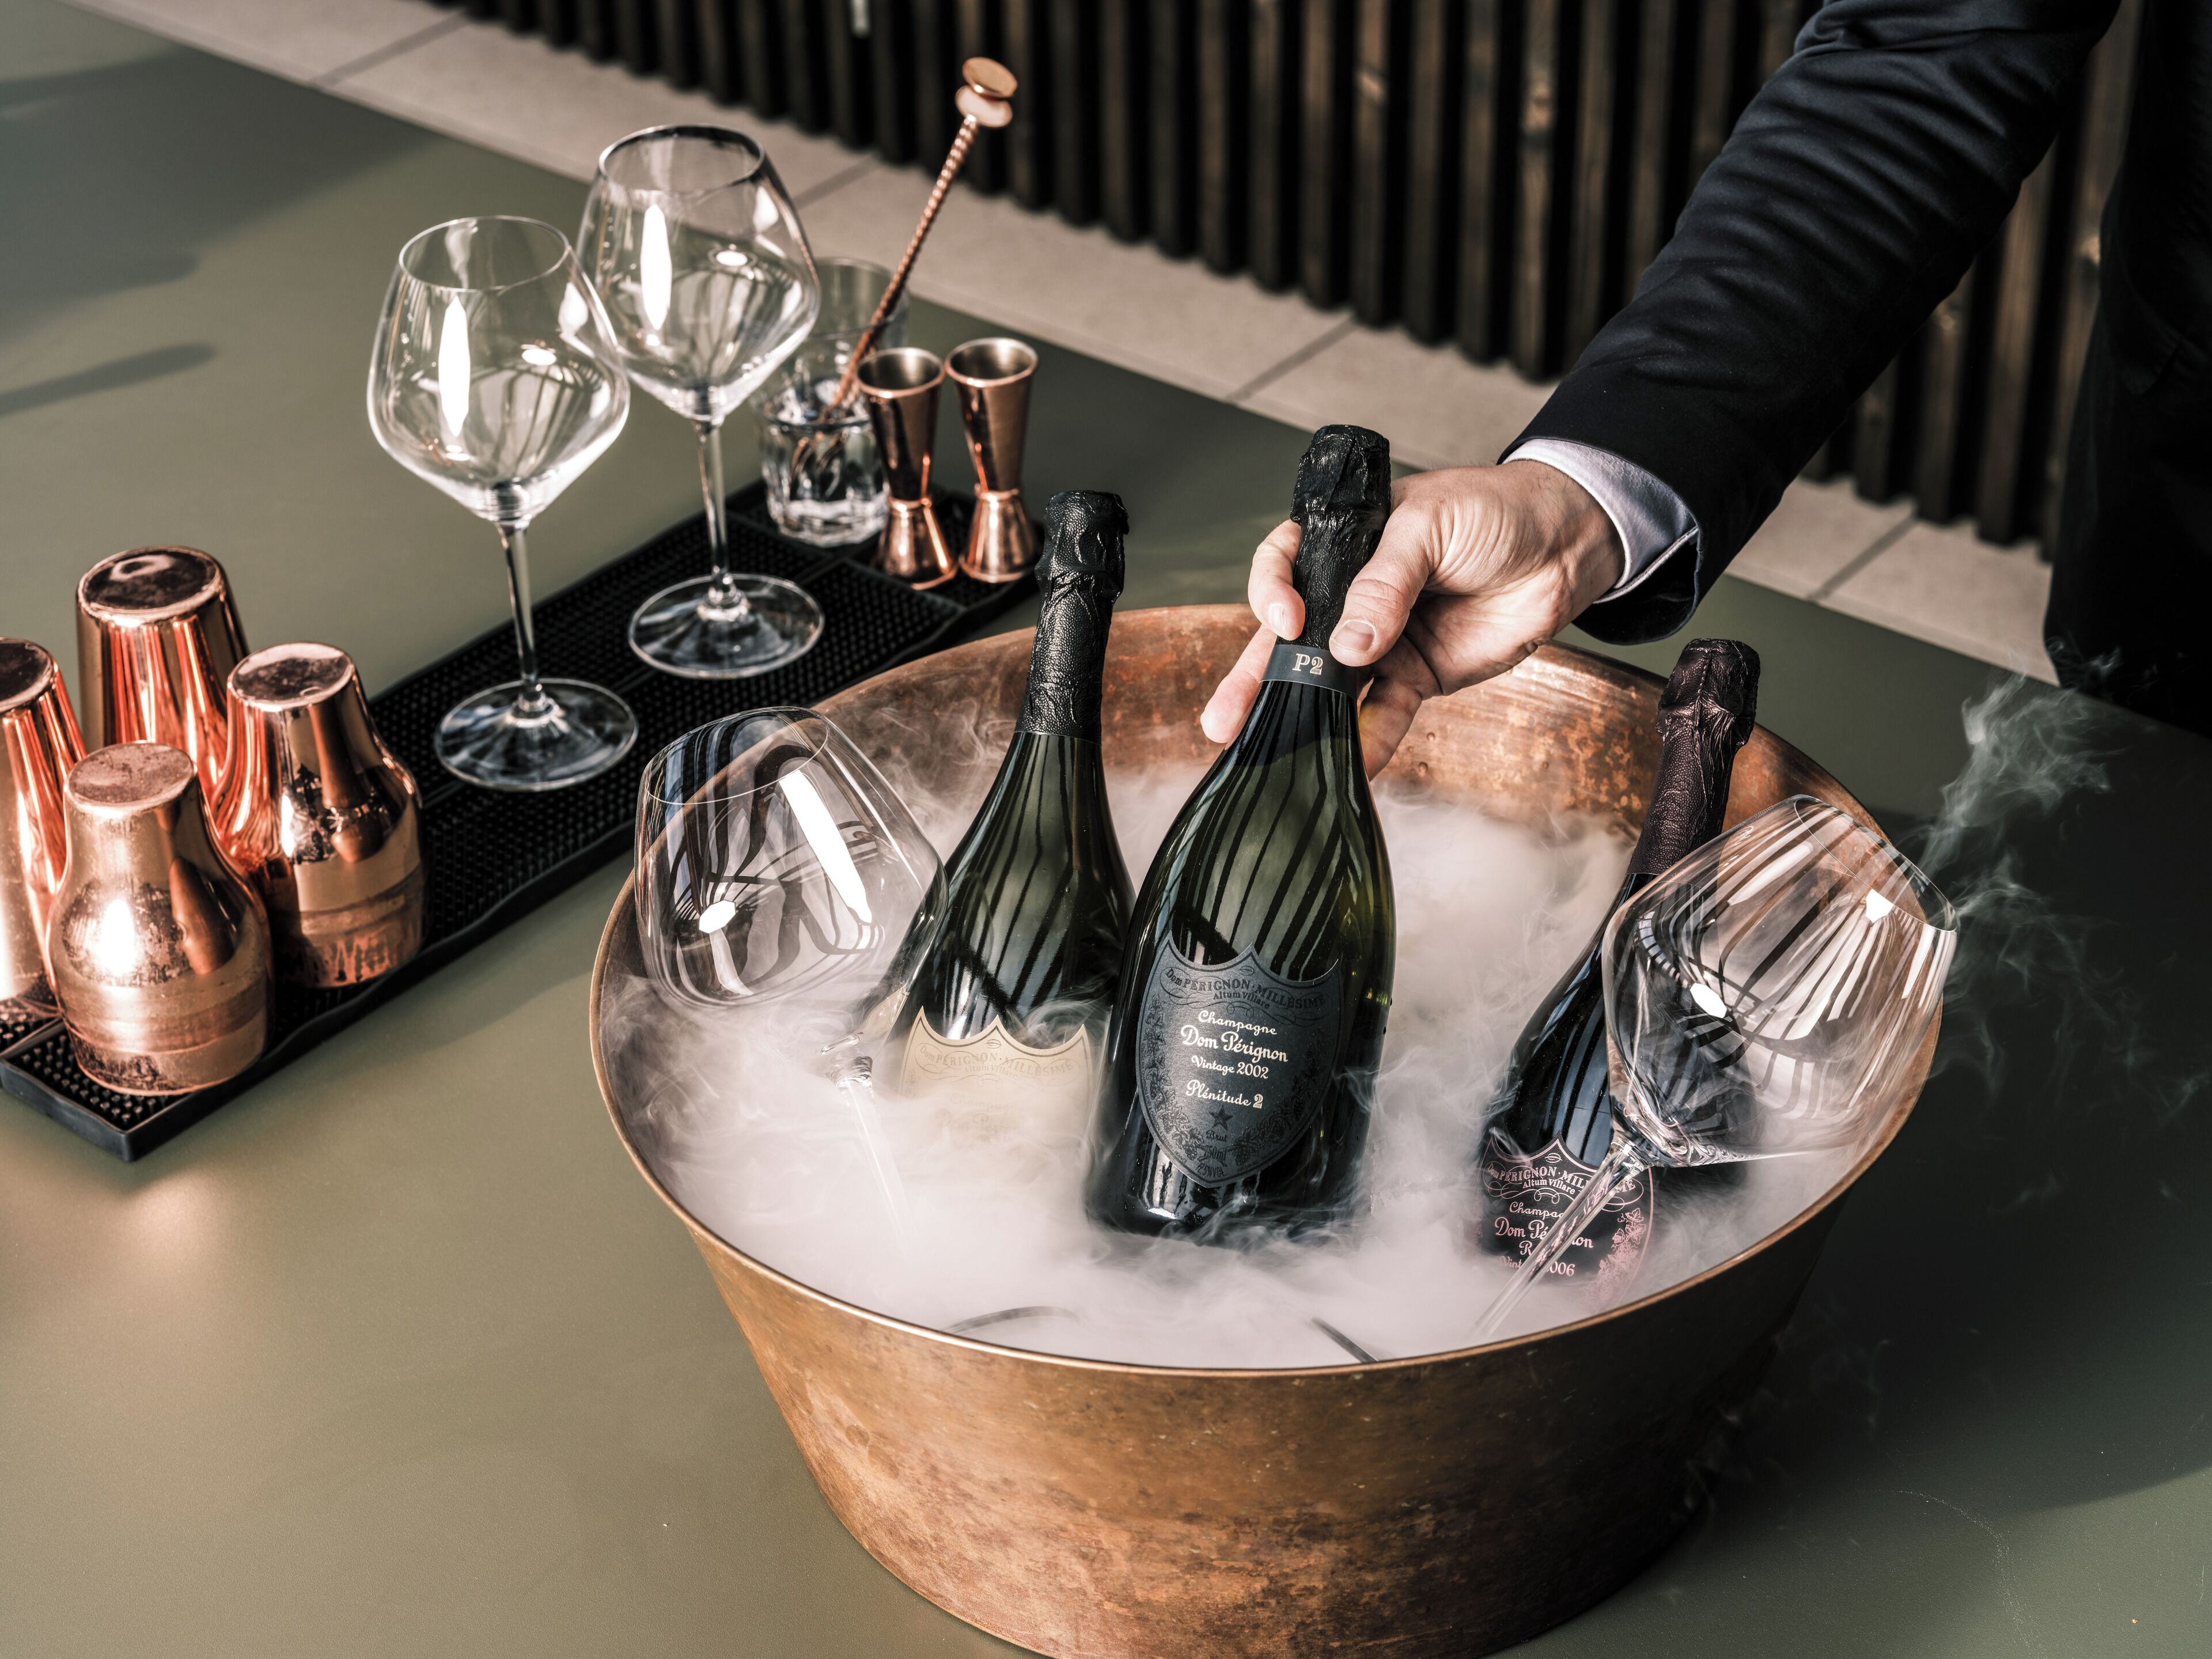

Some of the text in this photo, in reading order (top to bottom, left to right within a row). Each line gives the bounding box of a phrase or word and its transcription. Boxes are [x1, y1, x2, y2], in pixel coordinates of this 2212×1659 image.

[1292, 653, 1324, 676] P2
[1165, 968, 1183, 986] Dom
[1213, 991, 1271, 1009] Altum Villare
[1198, 1010, 1277, 1036] Champagne
[1181, 1025, 1289, 1063] Dom Pérignon
[1191, 1055, 1269, 1080] Vintage 2002
[1185, 1080, 1264, 1109] Plénitude 2
[1206, 1130, 1228, 1142] Brut
[1522, 1177, 1575, 1195] Altum Villare
[1494, 1217, 1526, 1237] Dom
[1546, 1261, 1576, 1277] 006
